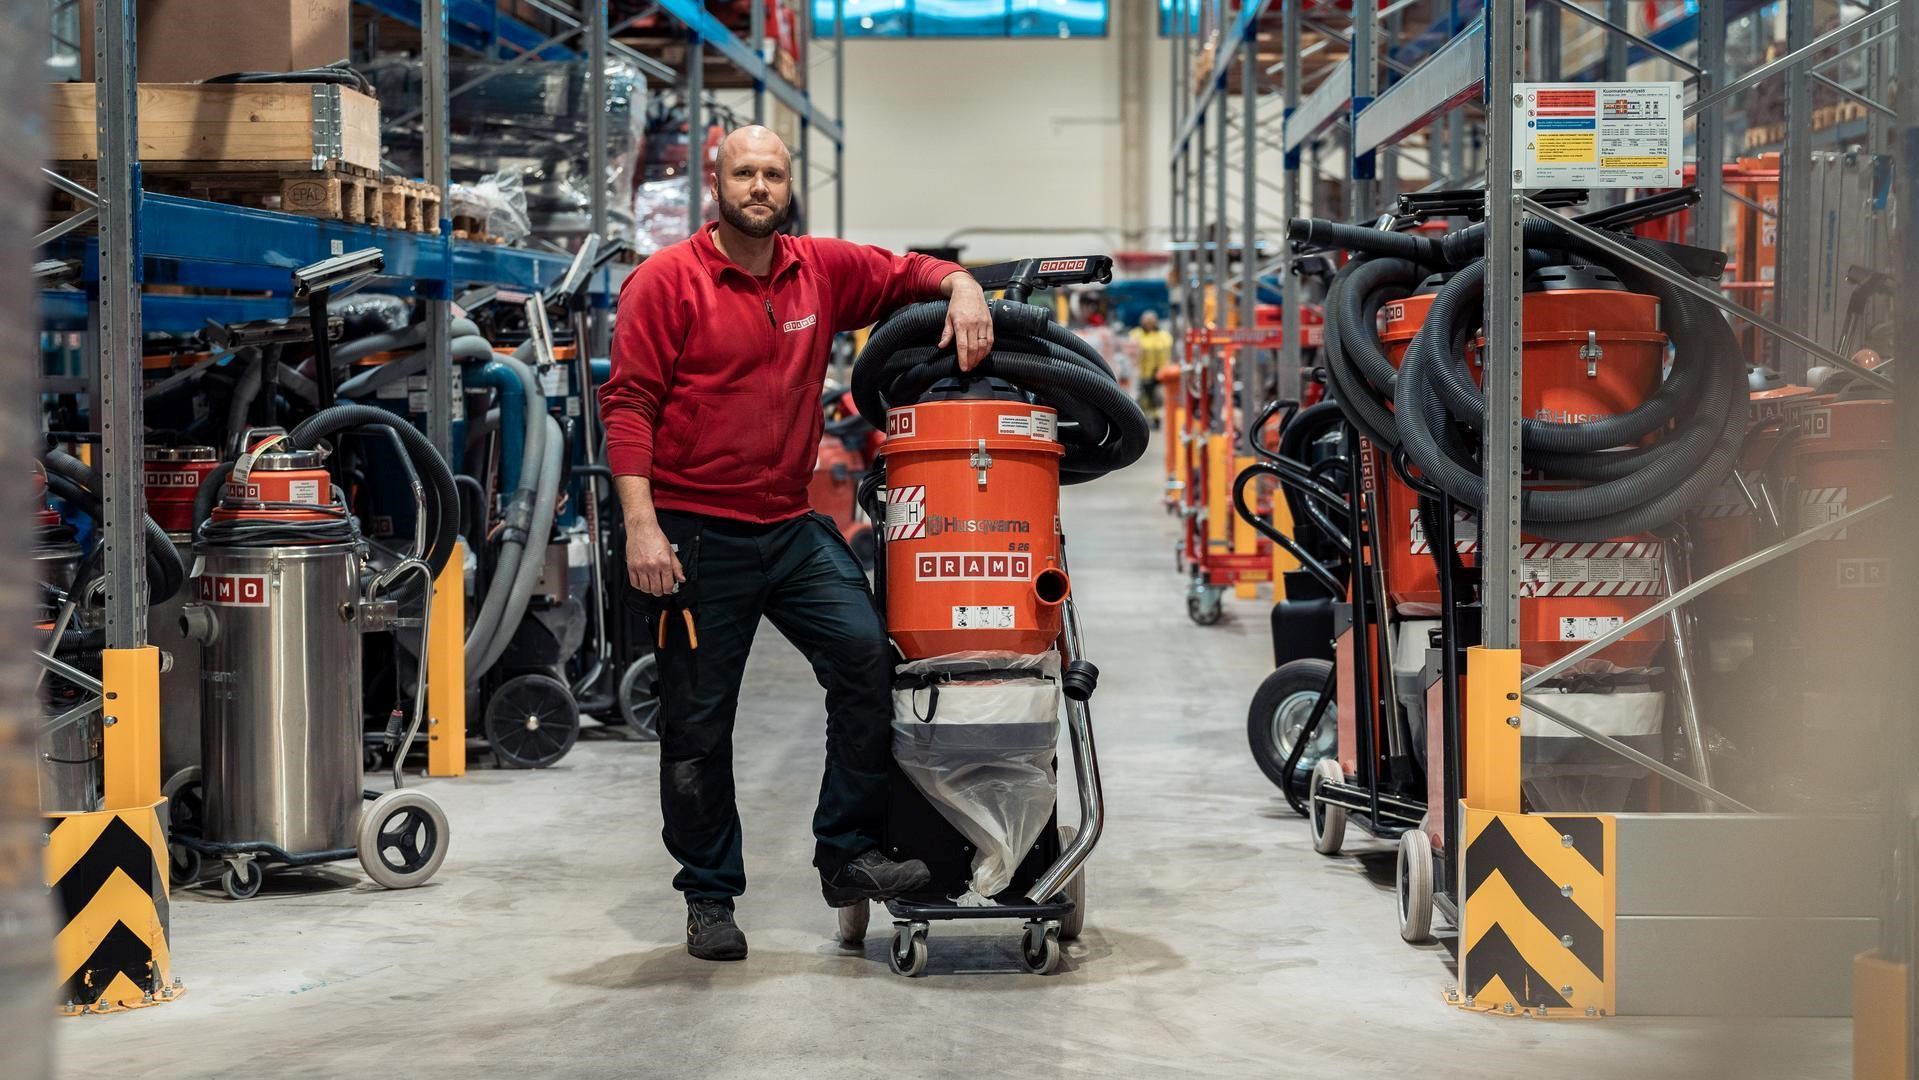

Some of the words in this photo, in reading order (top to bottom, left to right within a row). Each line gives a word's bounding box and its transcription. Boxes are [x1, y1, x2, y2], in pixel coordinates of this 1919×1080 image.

[1041, 261, 1084, 271] CRAMO
[1360, 440, 1373, 489] RAMO
[148, 472, 195, 484] RAMO
[908, 503, 918, 523] H
[943, 516, 1030, 534] Husqvarna
[1008, 543, 1015, 551] S
[1018, 543, 1030, 551] 26
[921, 559, 1026, 575] CRAMO
[202, 581, 258, 598] AMO
